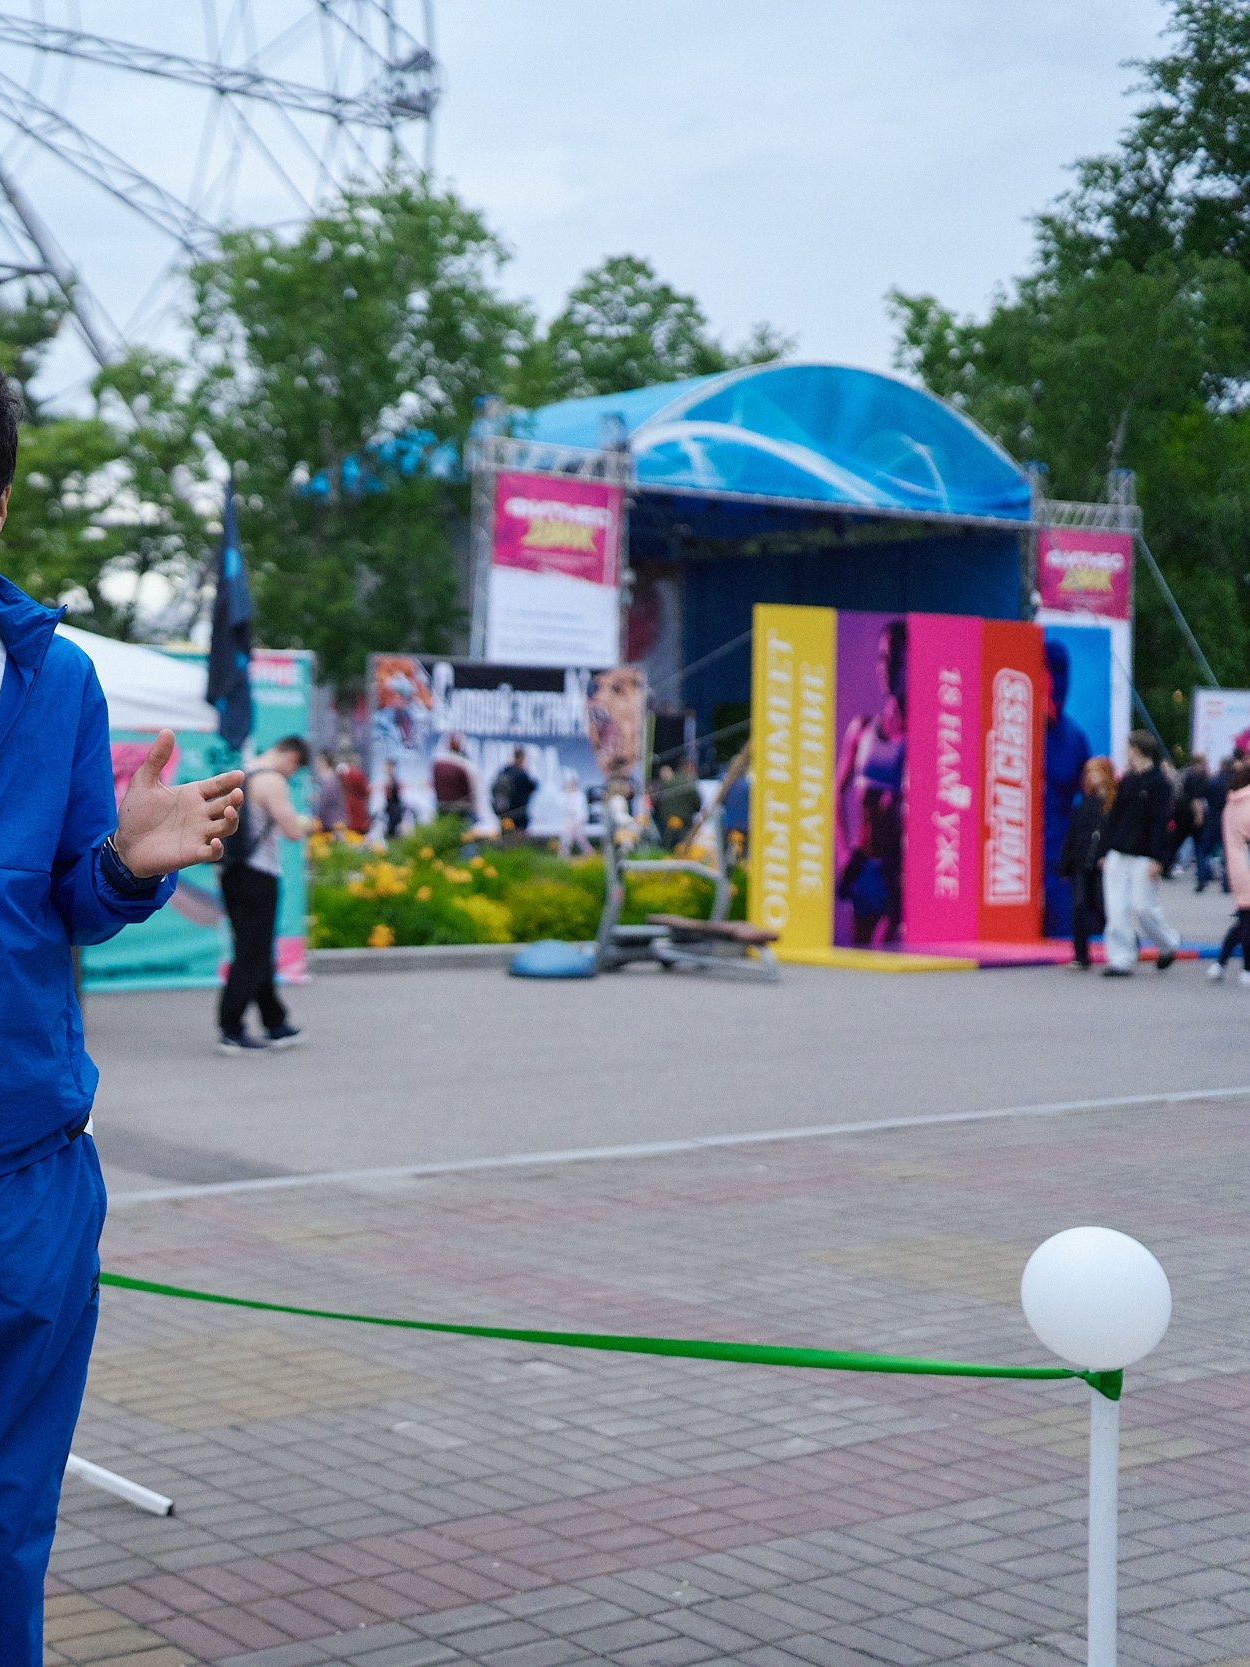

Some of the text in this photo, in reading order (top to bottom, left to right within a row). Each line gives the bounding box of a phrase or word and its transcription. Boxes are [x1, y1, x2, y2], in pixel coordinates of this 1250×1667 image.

[761, 627, 794, 929] ОПЫТ ИМЕЕТ
[797, 661, 826, 897] ЗНАЧЕНИЕ
[994, 675, 1031, 896] World Class
